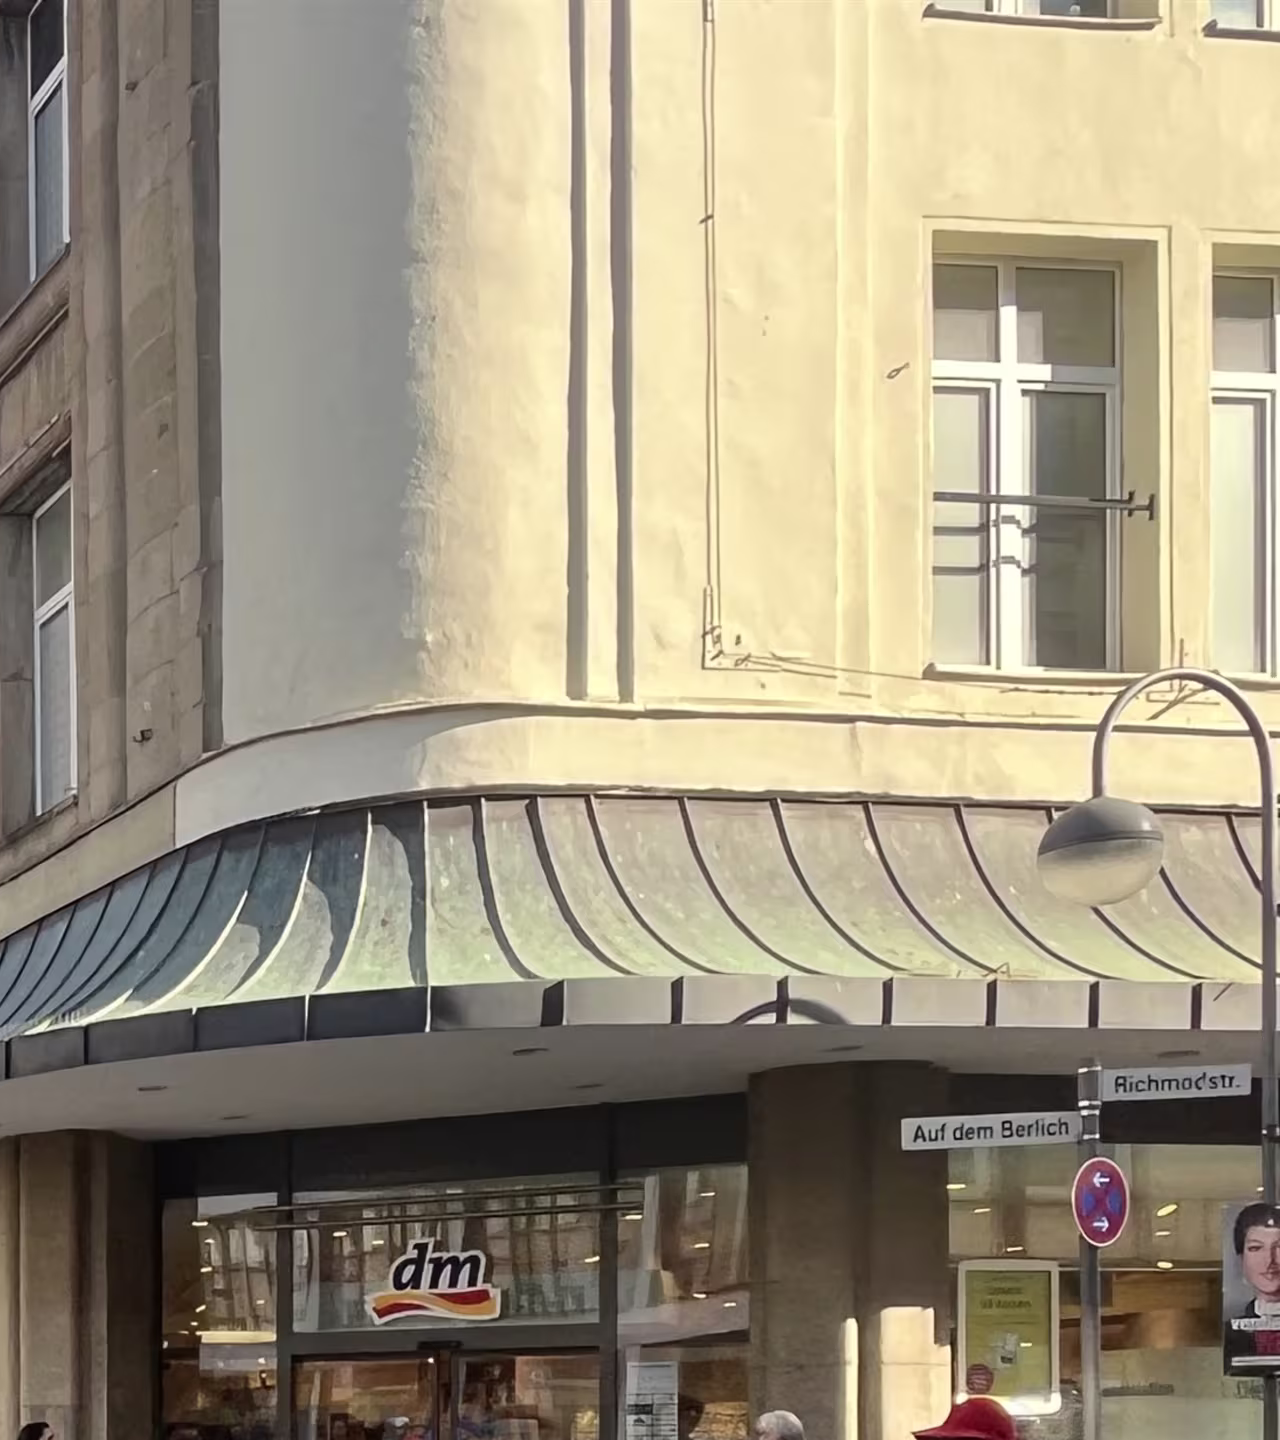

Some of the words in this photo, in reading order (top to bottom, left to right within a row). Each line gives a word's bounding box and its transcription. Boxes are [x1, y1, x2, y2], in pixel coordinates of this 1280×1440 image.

[1113, 1073, 1242, 1095] Richmodstr.
[912, 1123, 946, 1143] Auf
[952, 1122, 994, 1141] dem
[1001, 1117, 1070, 1139] Berlich
[391, 1242, 481, 1291] dm
